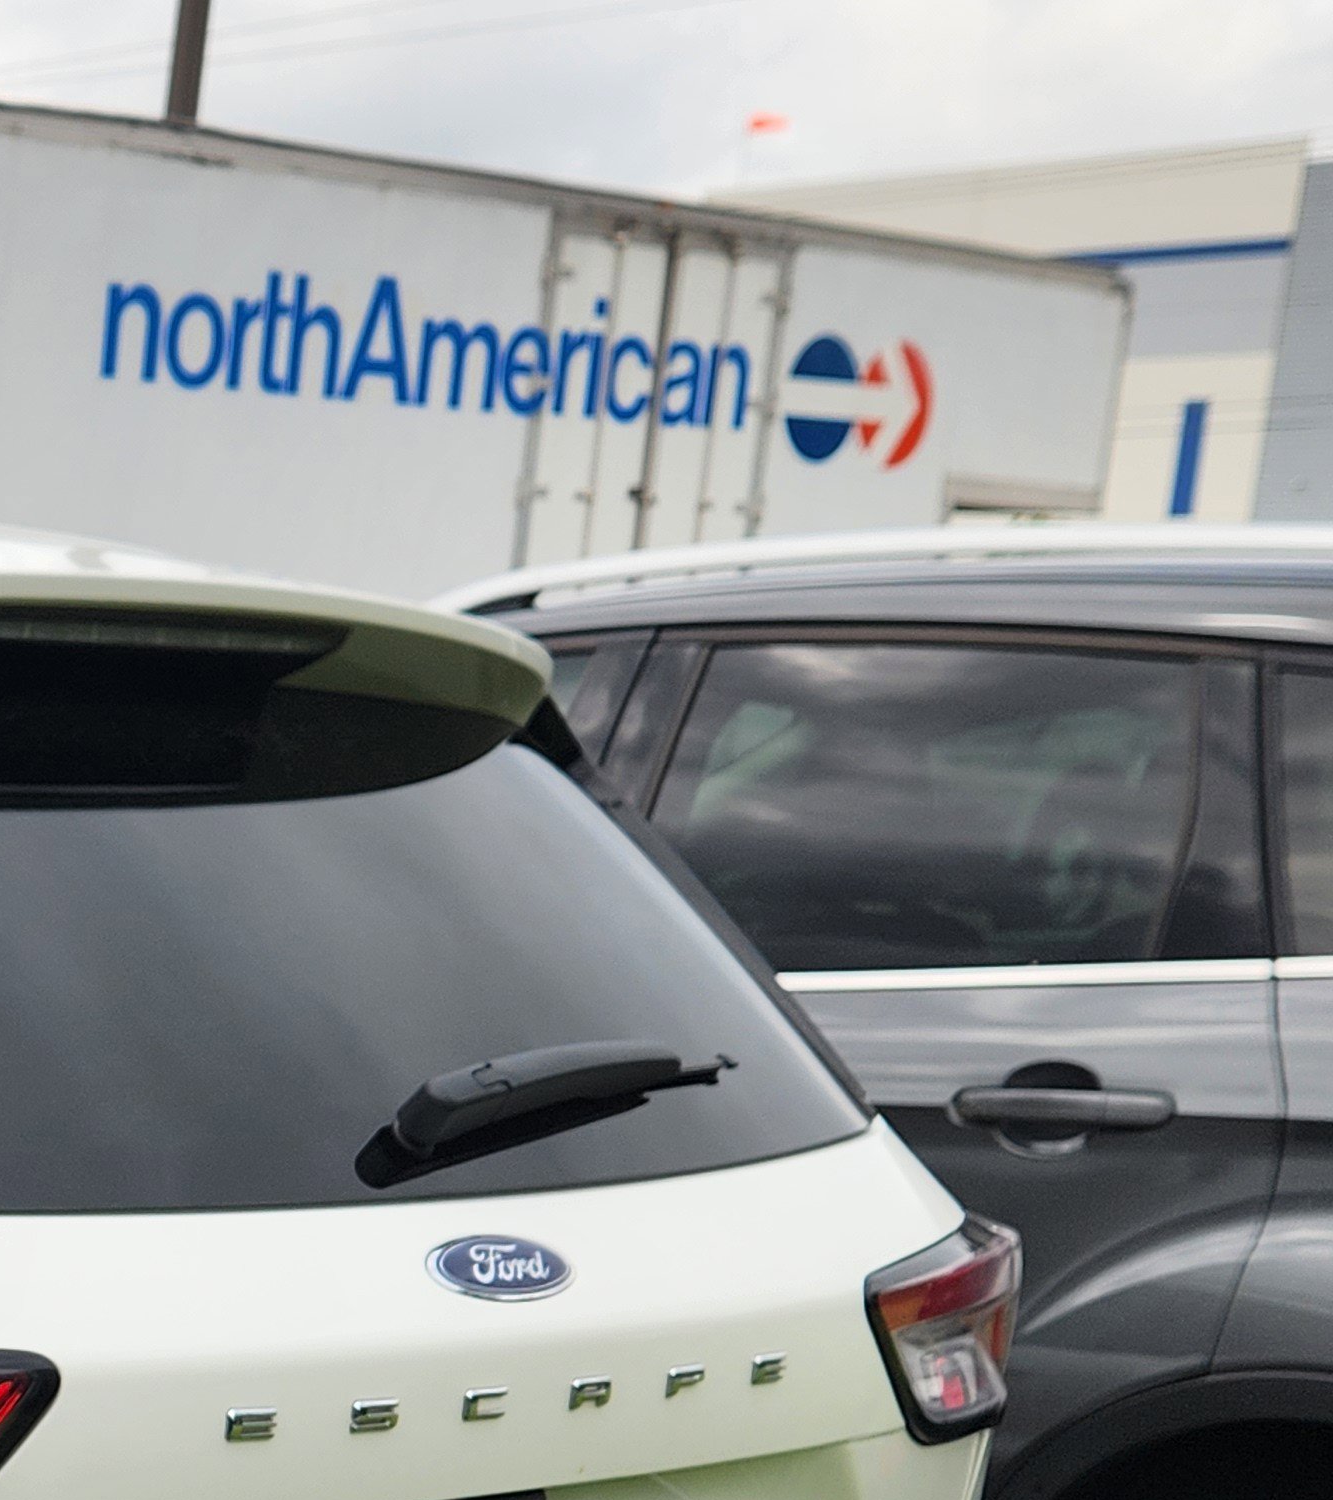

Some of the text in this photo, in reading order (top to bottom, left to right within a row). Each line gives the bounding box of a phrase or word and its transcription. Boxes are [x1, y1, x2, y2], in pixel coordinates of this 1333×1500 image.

[99, 270, 751, 433] northAmerican
[469, 1243, 550, 1284] Ford
[224, 1350, 788, 1443] ESCAPE
